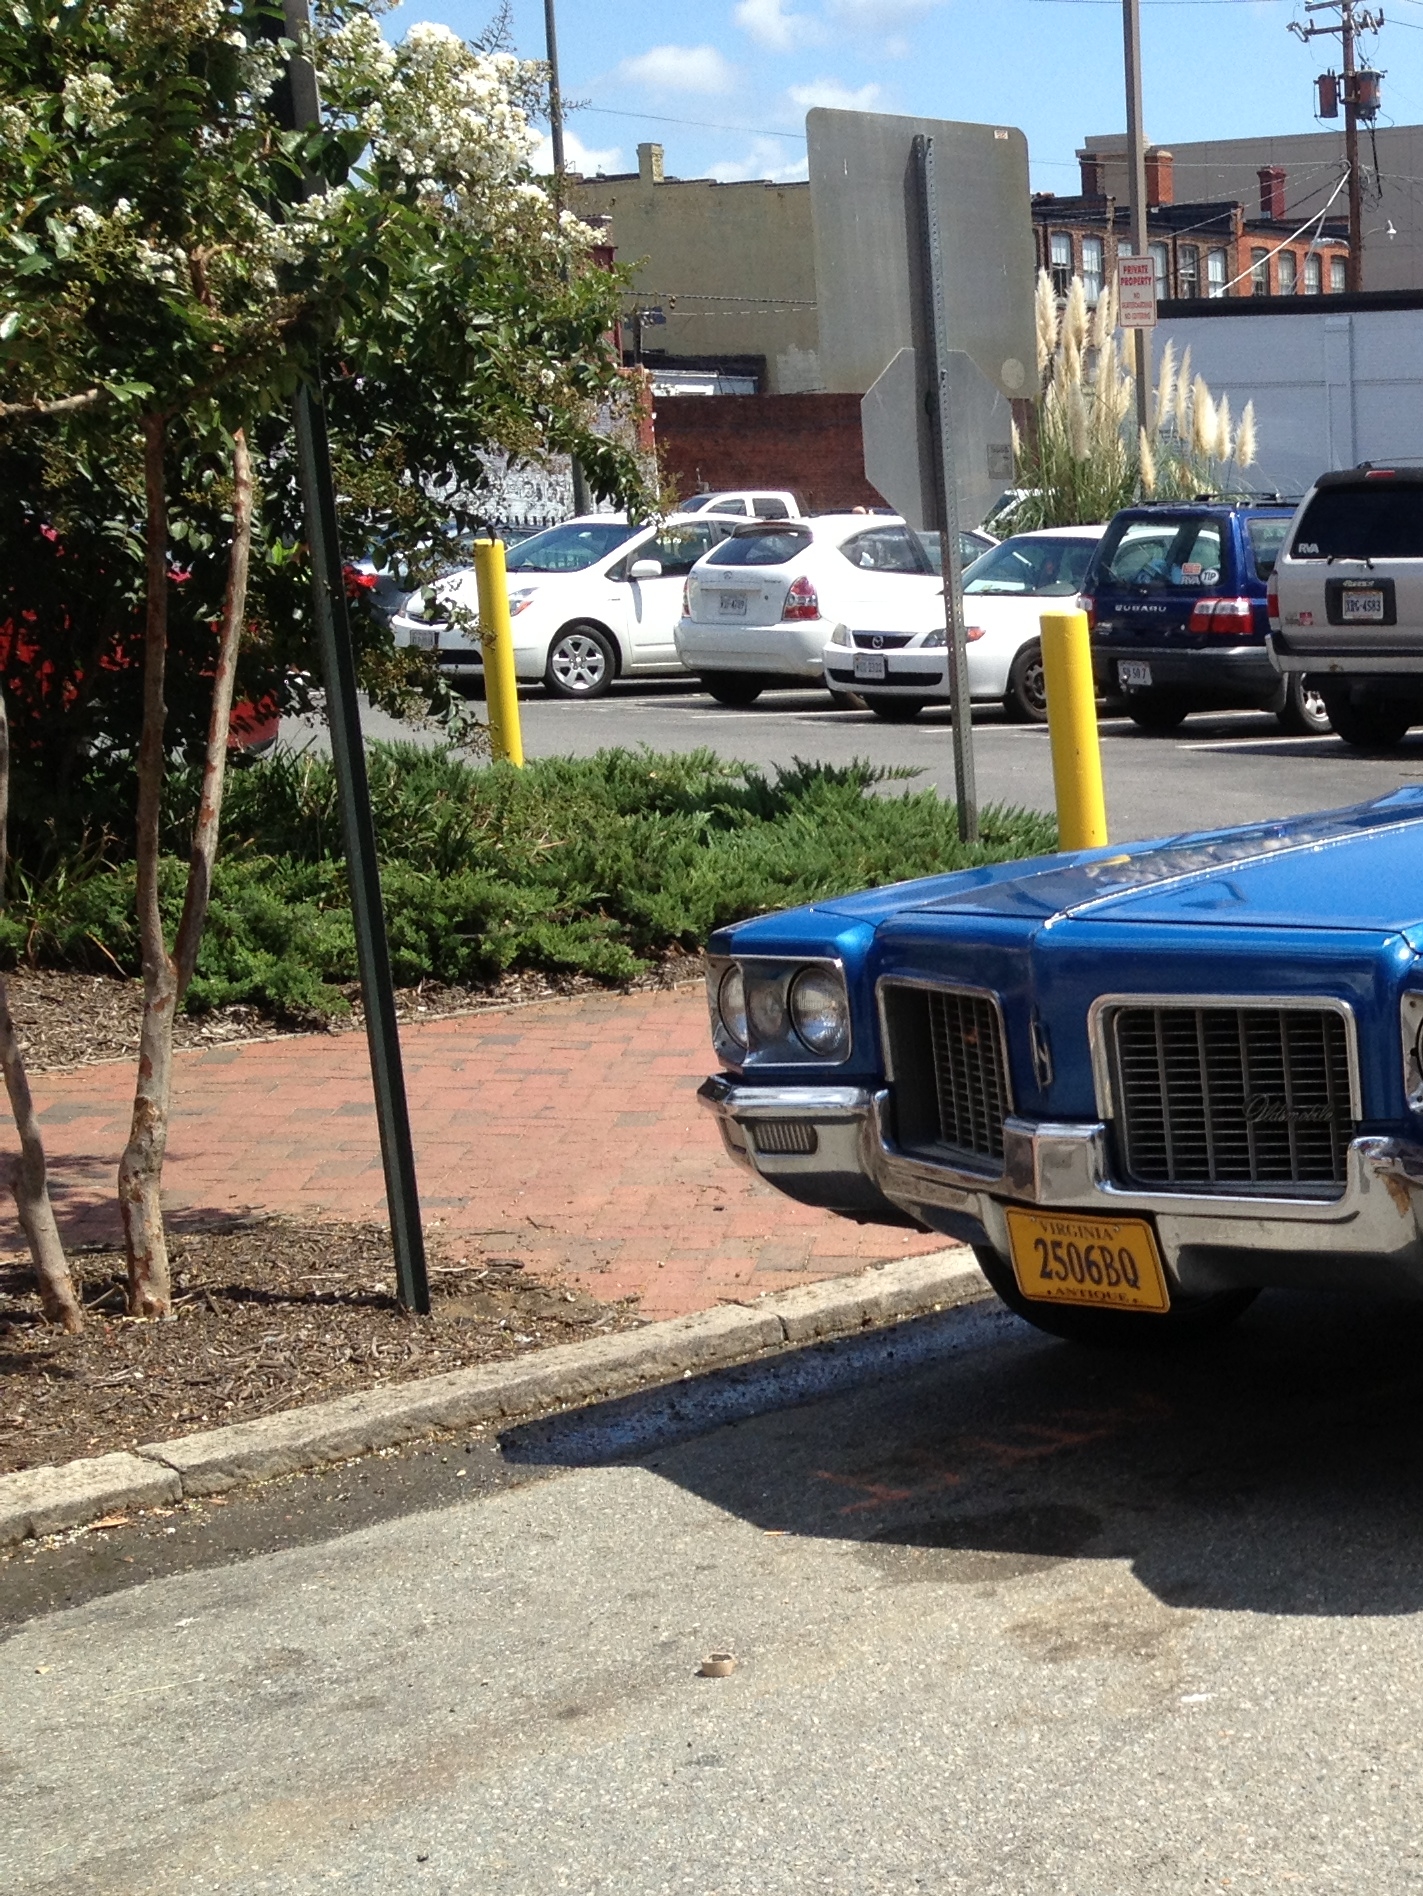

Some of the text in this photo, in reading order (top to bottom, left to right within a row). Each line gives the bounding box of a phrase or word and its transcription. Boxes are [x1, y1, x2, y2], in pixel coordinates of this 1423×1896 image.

[1123, 264, 1149, 274] PRIVATE
[1120, 276, 1152, 286] PROPERTY
[1298, 543, 1319, 554] RVA
[1115, 604, 1167, 612] SUBARU
[1039, 1219, 1114, 1241] VIRGINIA
[1033, 1237, 1141, 1290] 2506BQ
[1052, 1287, 1127, 1300] ANTIQUE
